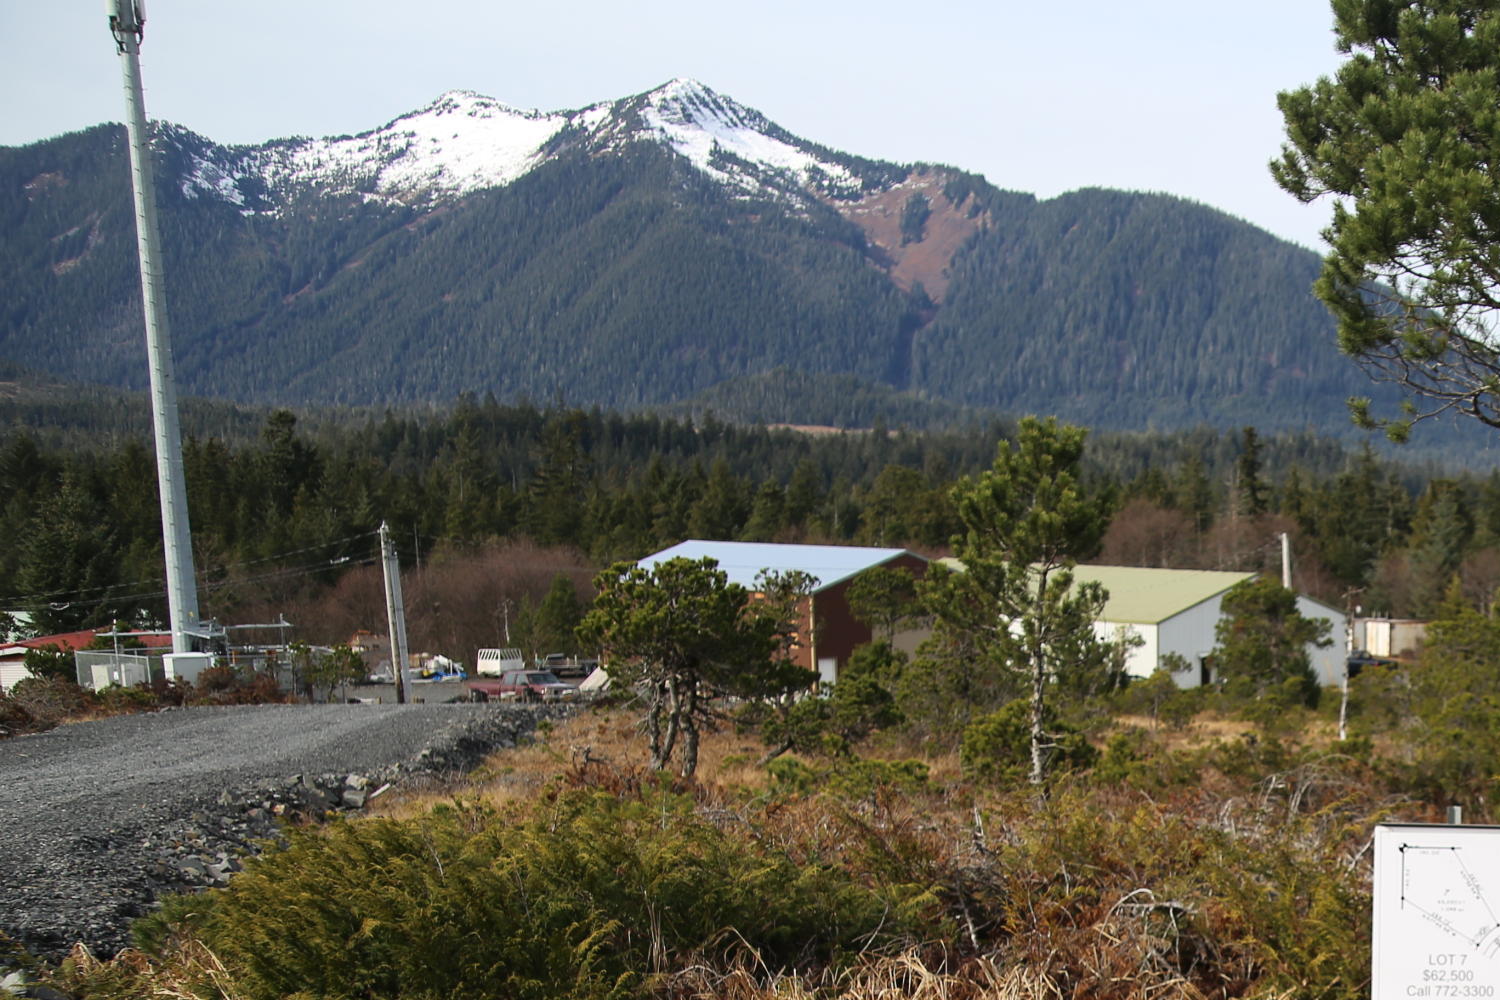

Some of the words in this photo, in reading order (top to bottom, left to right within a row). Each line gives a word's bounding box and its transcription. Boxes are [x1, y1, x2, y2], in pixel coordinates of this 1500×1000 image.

[1428, 954, 1456, 966] LOT
[1460, 954, 1468, 966] 7
[1423, 969, 1474, 982] $62,500
[1406, 985, 1431, 997] Call
[1435, 985, 1494, 997] 772-3300
